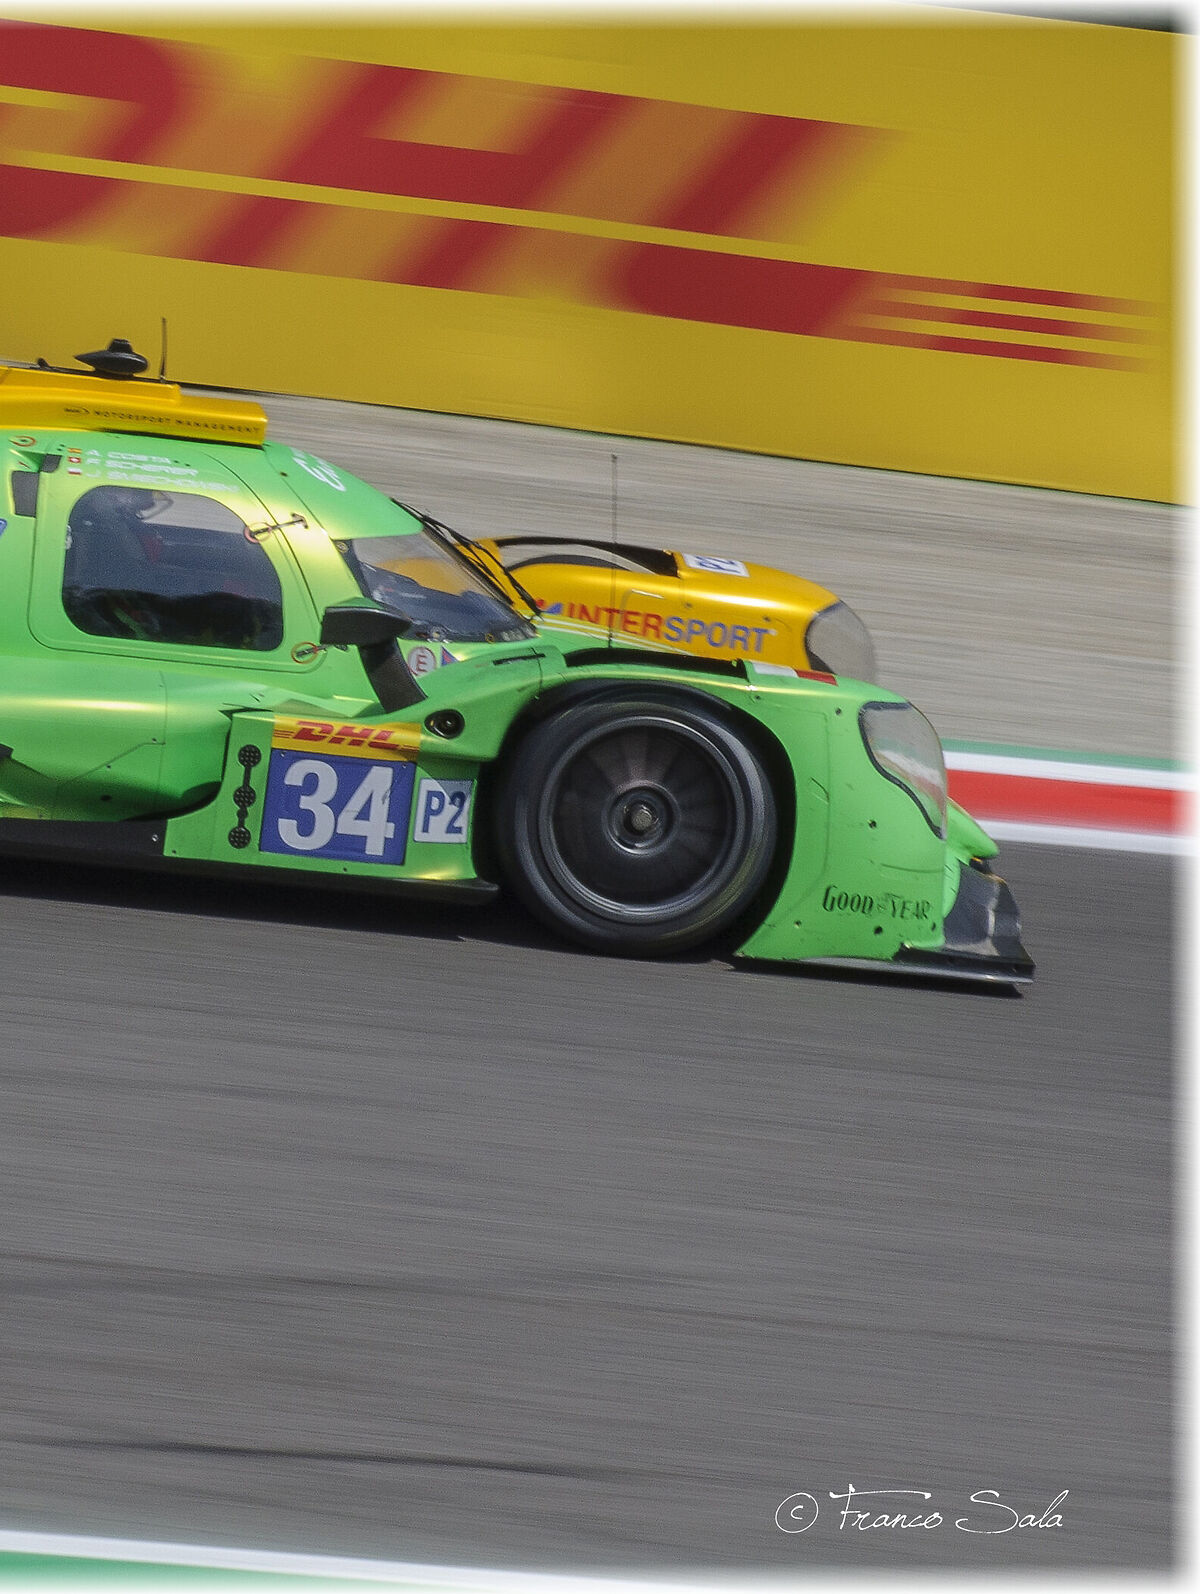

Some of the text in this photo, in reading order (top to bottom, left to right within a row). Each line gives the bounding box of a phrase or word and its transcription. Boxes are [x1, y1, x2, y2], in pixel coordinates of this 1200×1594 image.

[568, 602, 770, 653] INTERSPORT
[292, 720, 401, 750] DHL
[277, 758, 396, 857] 34
[421, 789, 467, 835] P2
